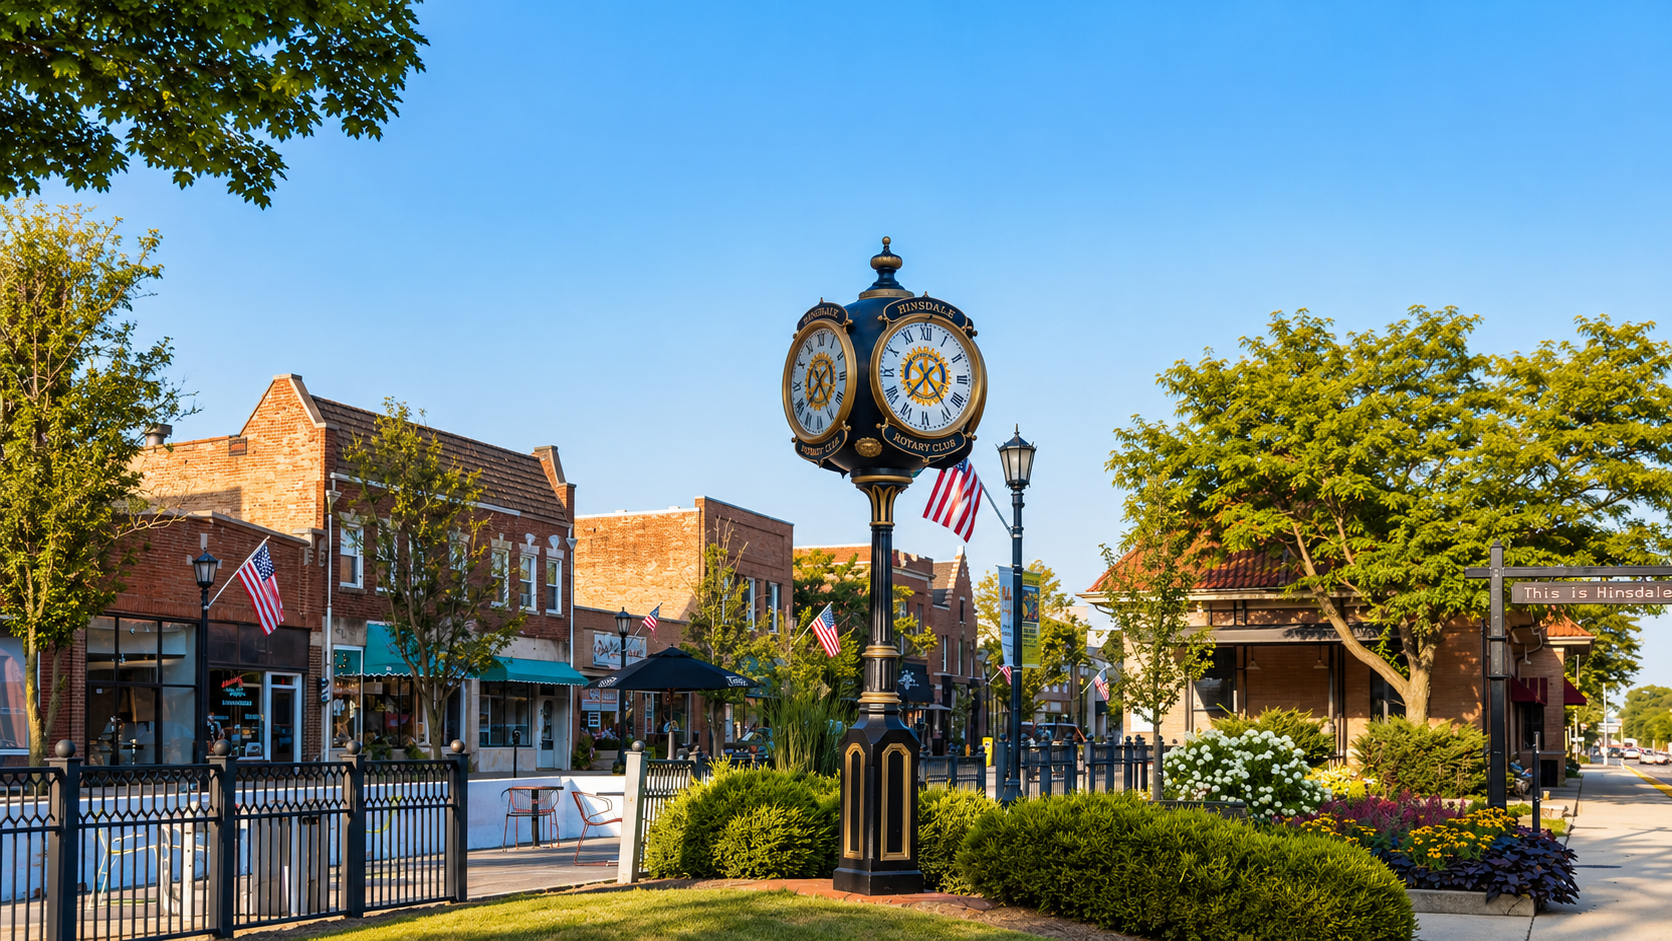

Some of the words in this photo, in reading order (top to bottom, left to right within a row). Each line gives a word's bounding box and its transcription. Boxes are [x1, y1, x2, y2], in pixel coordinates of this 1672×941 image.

[897, 301, 956, 319] HINSDALE
[920, 326, 932, 341] XII
[956, 375, 968, 385] III
[893, 432, 930, 452] ROTARY
[932, 439, 956, 452] CLUB
[1523, 586, 1560, 599] This
[1571, 586, 1588, 599] is
[1597, 586, 1672, 599] Hinsdale
